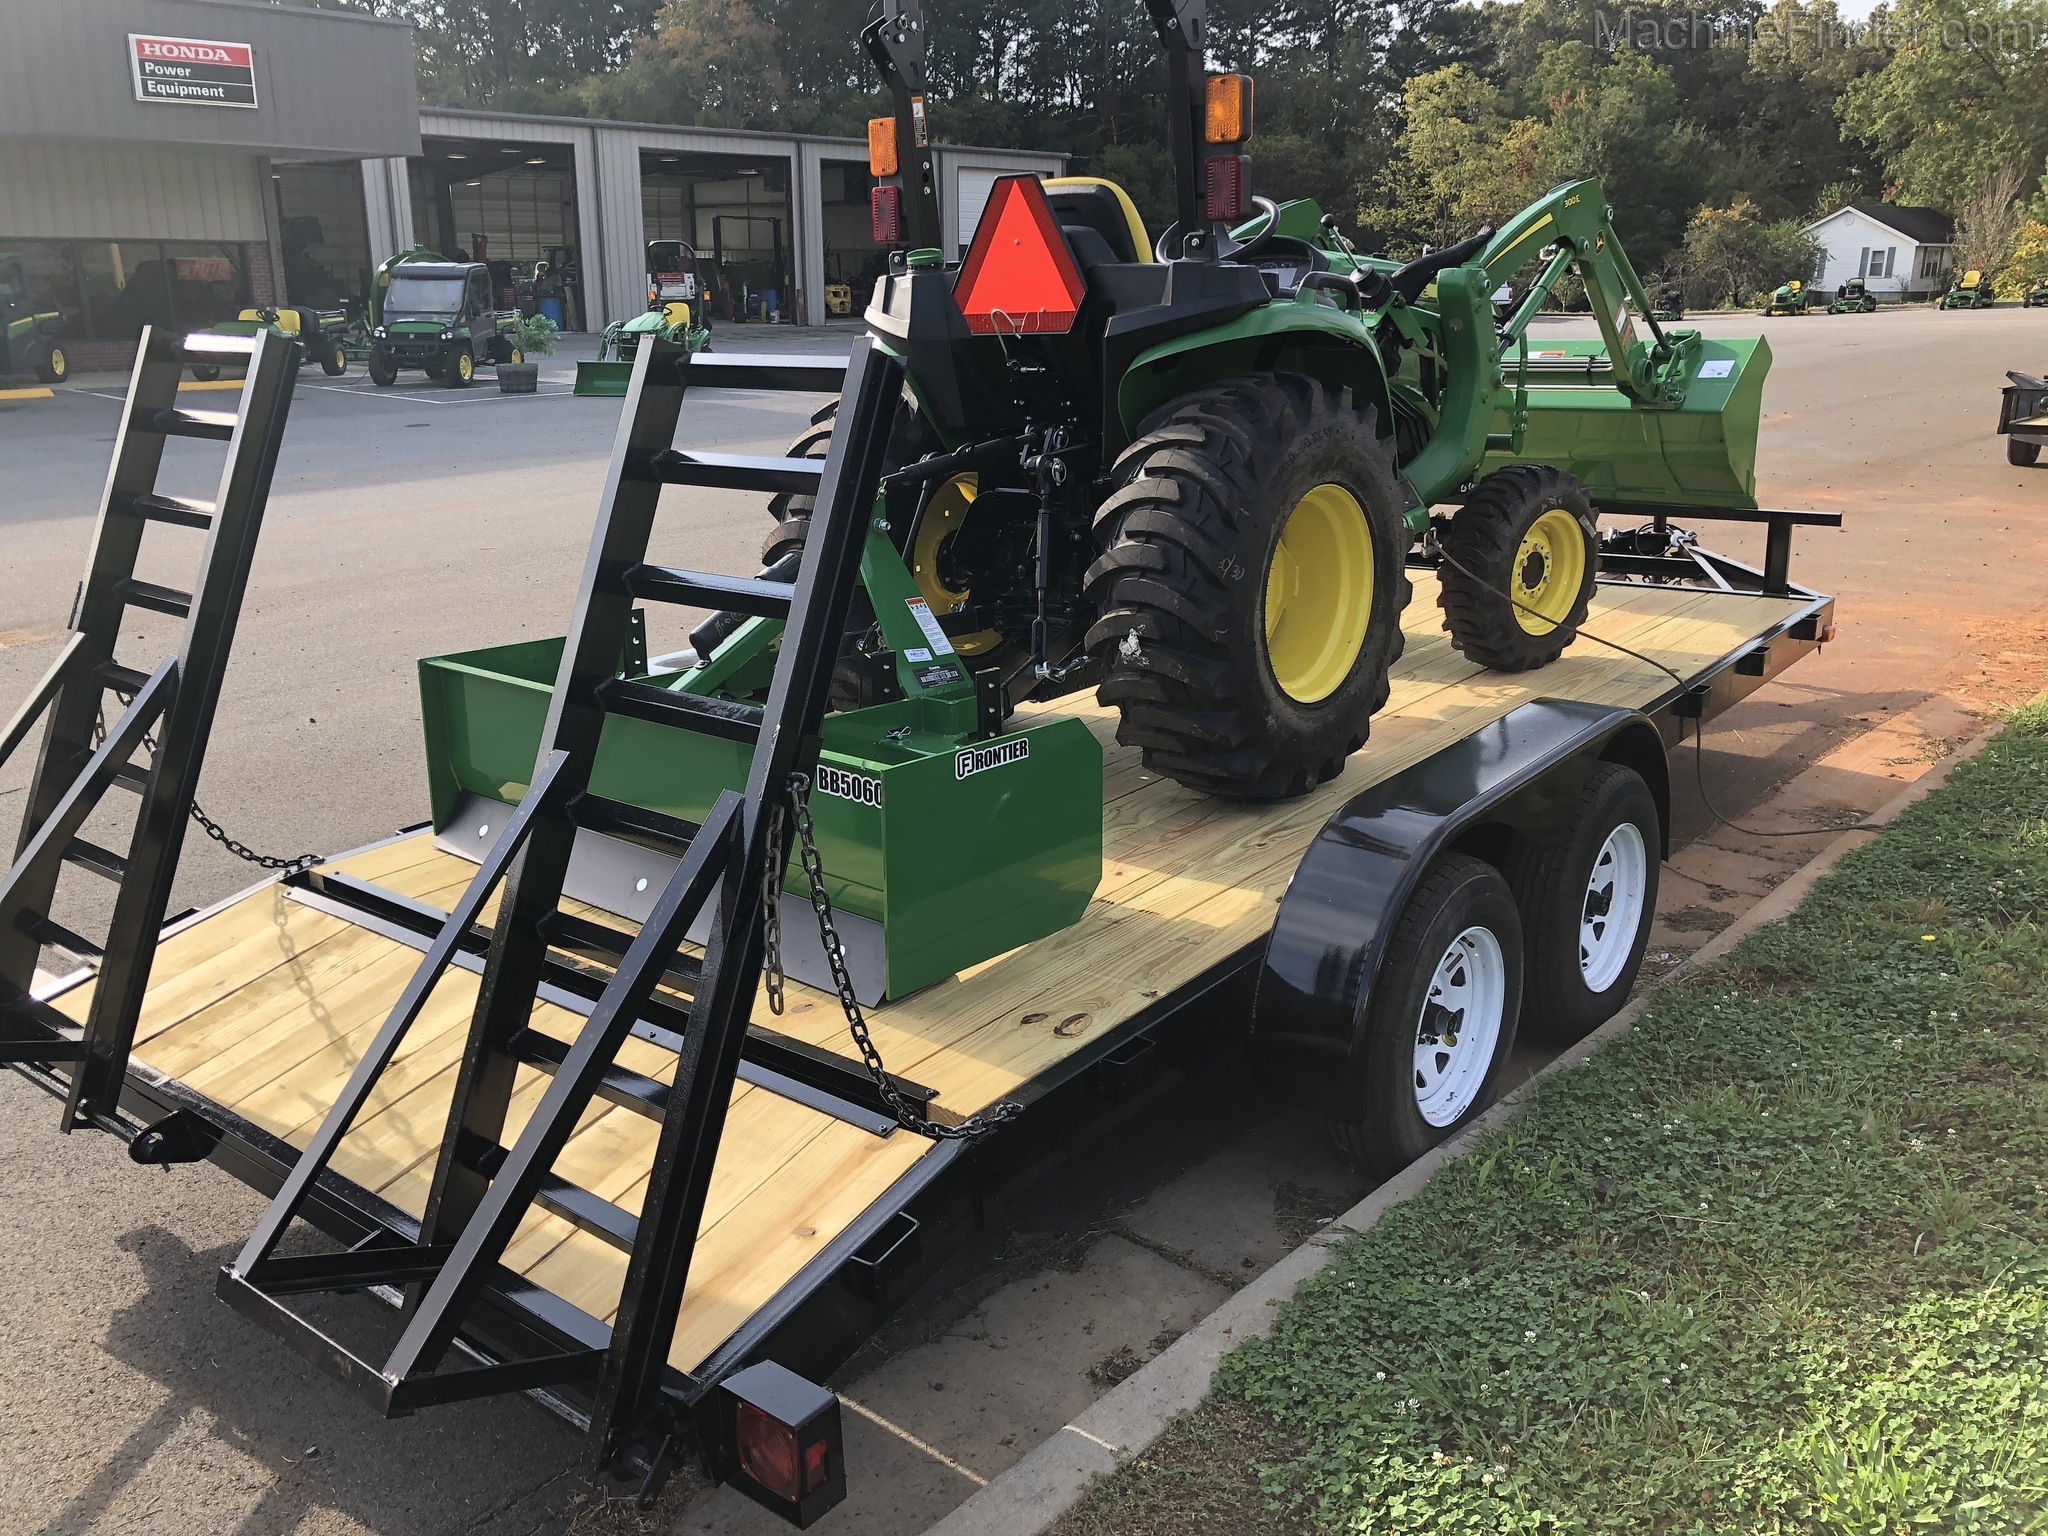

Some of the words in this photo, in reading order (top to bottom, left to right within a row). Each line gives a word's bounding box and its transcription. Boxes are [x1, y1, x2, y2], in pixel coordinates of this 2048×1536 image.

[142, 42, 231, 62] HONDA
[144, 61, 191, 77] Power
[147, 80, 225, 98] Equipment
[1564, 194, 1580, 208] 300E
[956, 738, 1029, 780] FRONTIER
